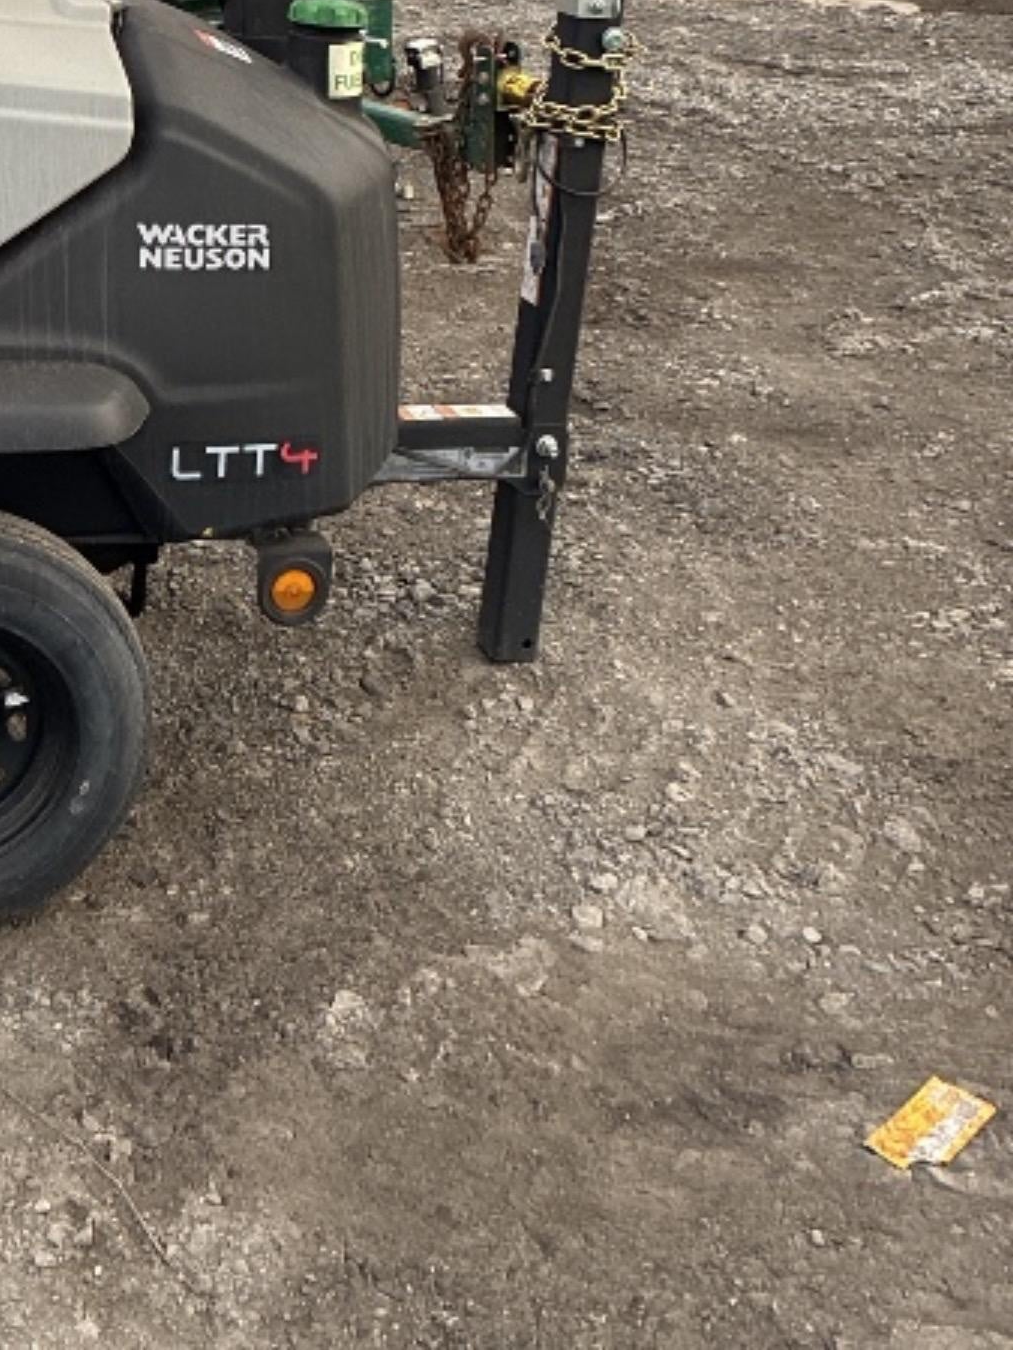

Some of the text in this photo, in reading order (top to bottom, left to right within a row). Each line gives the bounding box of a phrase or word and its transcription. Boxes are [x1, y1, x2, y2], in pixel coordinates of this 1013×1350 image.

[137, 222, 271, 247] WACKER
[139, 247, 271, 271] NEUSON
[172, 441, 319, 481] LTT4
